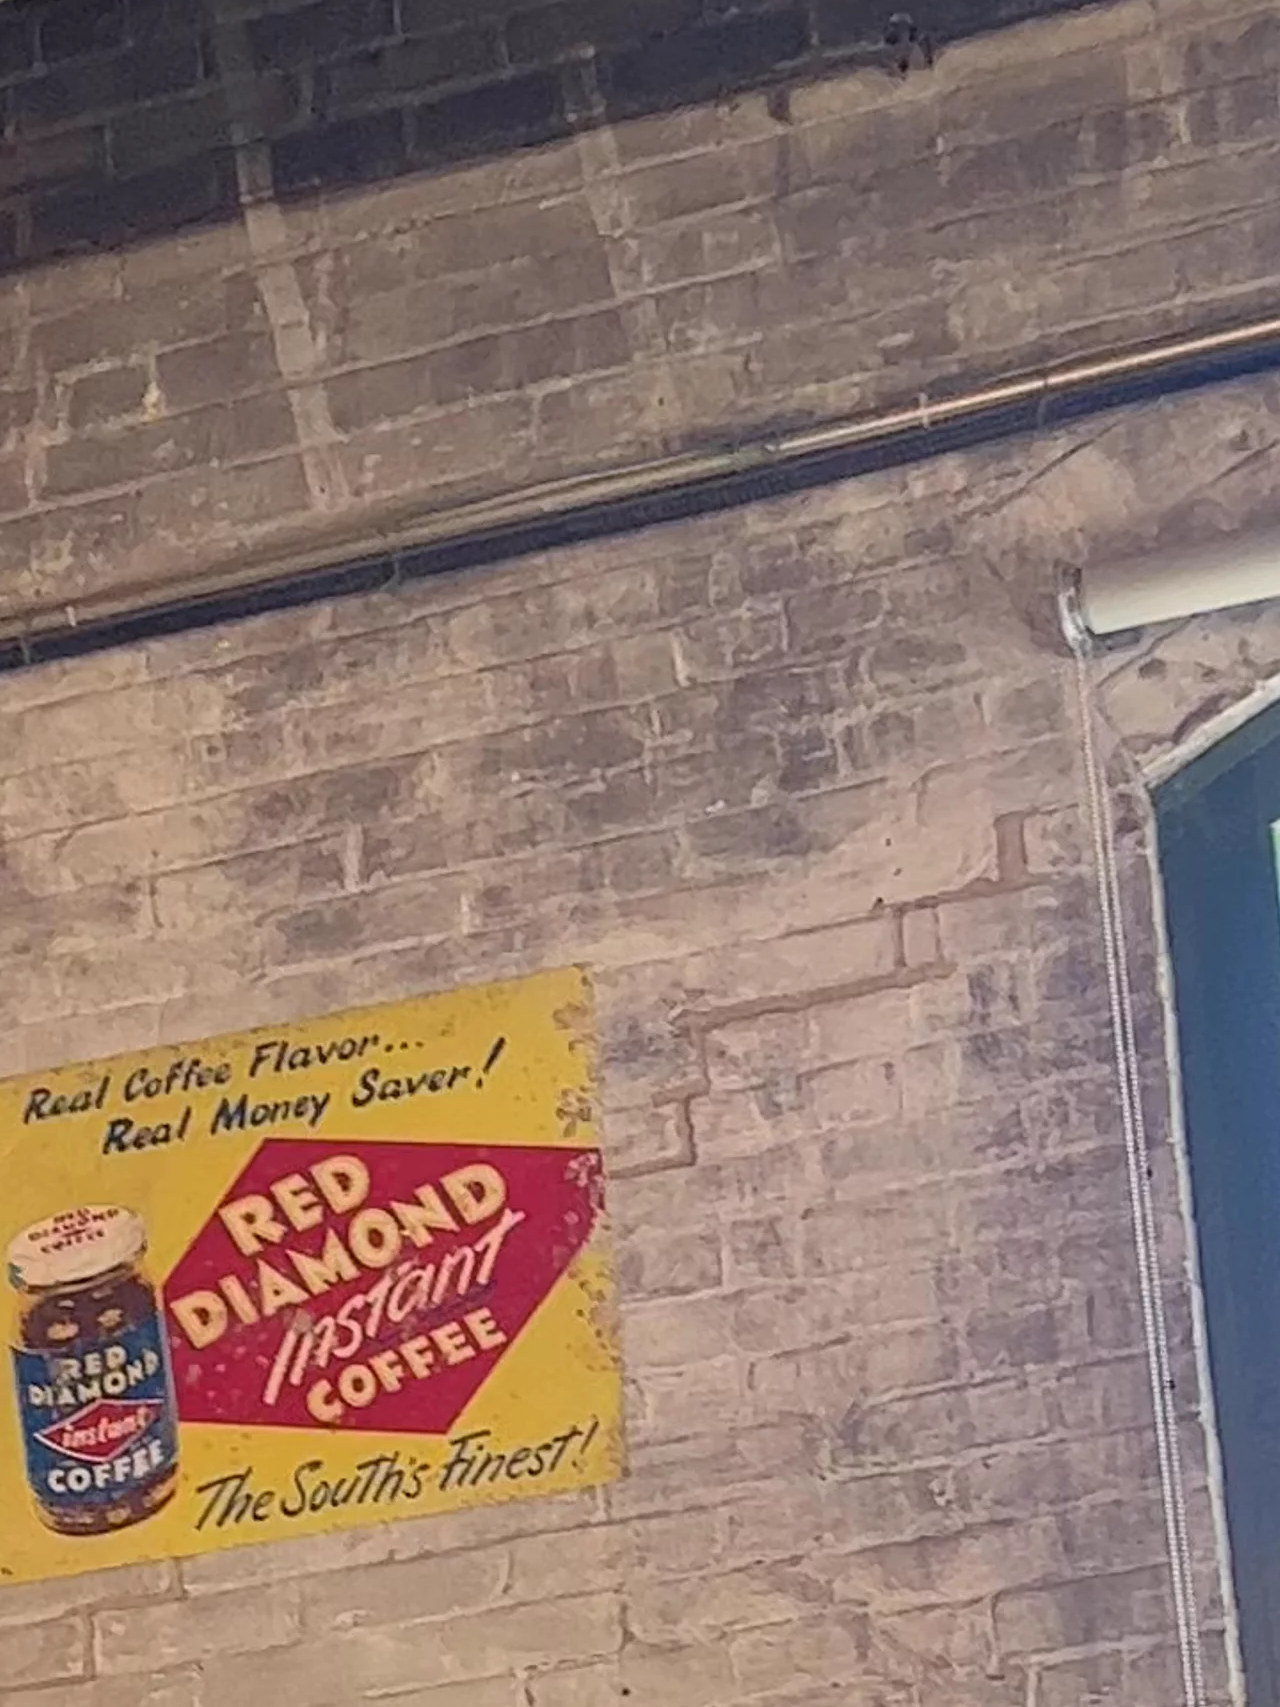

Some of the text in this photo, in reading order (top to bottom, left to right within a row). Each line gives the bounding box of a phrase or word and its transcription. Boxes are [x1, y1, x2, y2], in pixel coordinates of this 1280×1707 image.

[22, 1073, 109, 1125] Real
[124, 1055, 232, 1106] Coffee
[102, 1037, 506, 1155] Real Money Saver!
[169, 1162, 507, 1349] DIAMOND
[220, 1153, 371, 1256] RED
[261, 1208, 525, 1406] Instant
[28, 1348, 160, 1406] DIAMOND
[59, 1345, 126, 1379] RED
[305, 1305, 507, 1423] COFFEE
[47, 1439, 164, 1492] COFFEE
[62, 1406, 153, 1449] instant
[194, 1466, 276, 1532] The
[438, 1420, 600, 1488] Finest!
